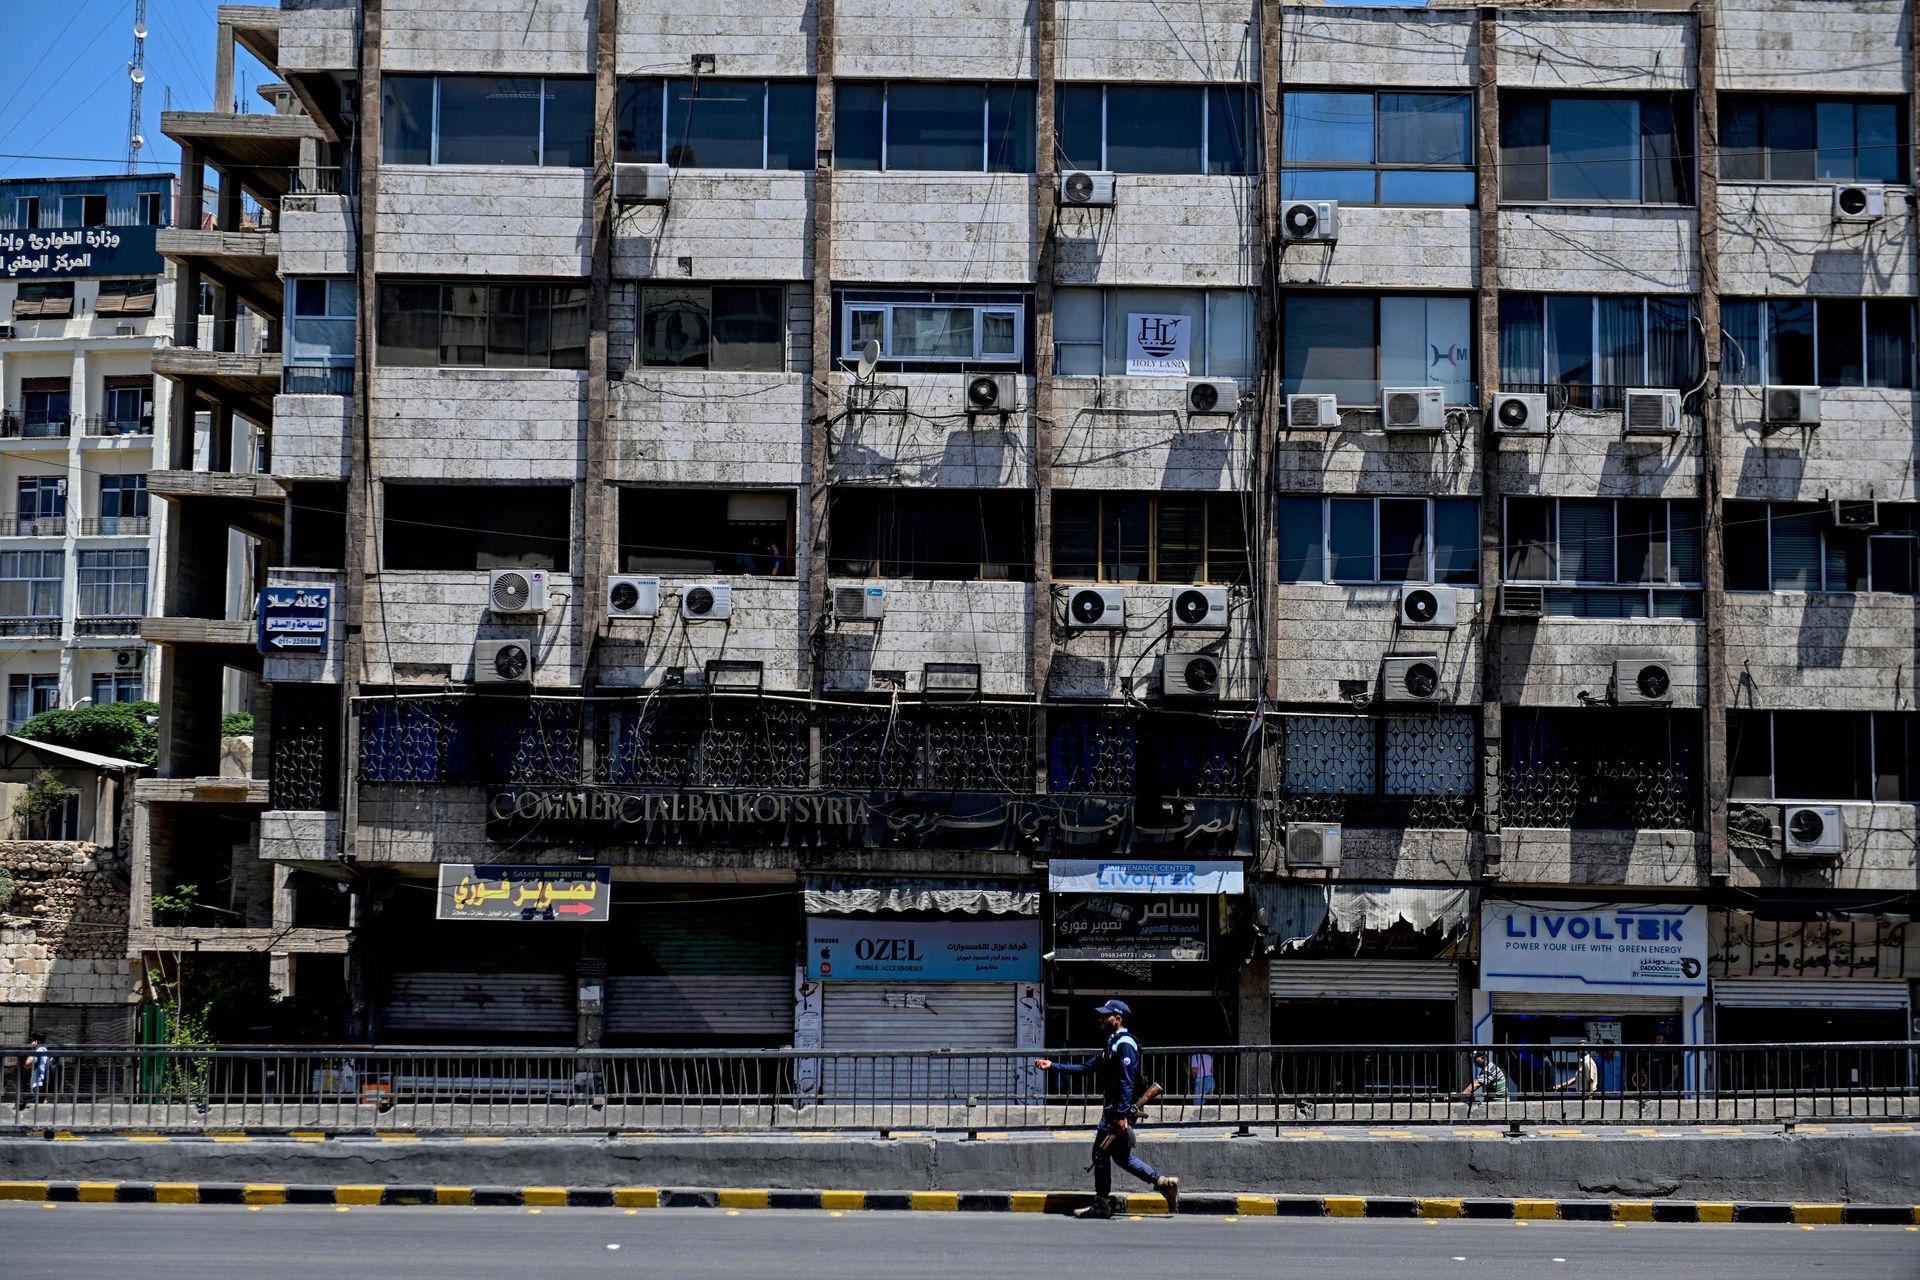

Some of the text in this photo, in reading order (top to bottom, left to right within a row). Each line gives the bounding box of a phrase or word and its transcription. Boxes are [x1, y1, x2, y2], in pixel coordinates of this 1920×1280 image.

[28, 231, 83, 250] الطوارئ
[86, 230, 120, 248] وزارة
[8, 254, 48, 277] الوطني
[52, 253, 91, 271] المركز
[1132, 359, 1185, 368] HOLY LAND
[294, 590, 328, 609] وكالة
[268, 619, 324, 630] للسياحة والسفر
[692, 794, 754, 823] BANK
[753, 795, 793, 822] OF
[794, 796, 871, 825] SYRIA
[1098, 872, 1196, 886] LIVOLTEK
[454, 871, 597, 910] تصوير فوري
[1137, 896, 1200, 926] سامر
[1060, 920, 1122, 935] تصوير فوري
[1506, 915, 1684, 942] LIVOLTEK
[855, 938, 924, 961] OZEL
[1008, 941, 1028, 951] شركة
[1506, 942, 1682, 954] POWER YOUR LIFE WITH GREEN ENERGY
[880, 964, 924, 972] ACCESSORIES
